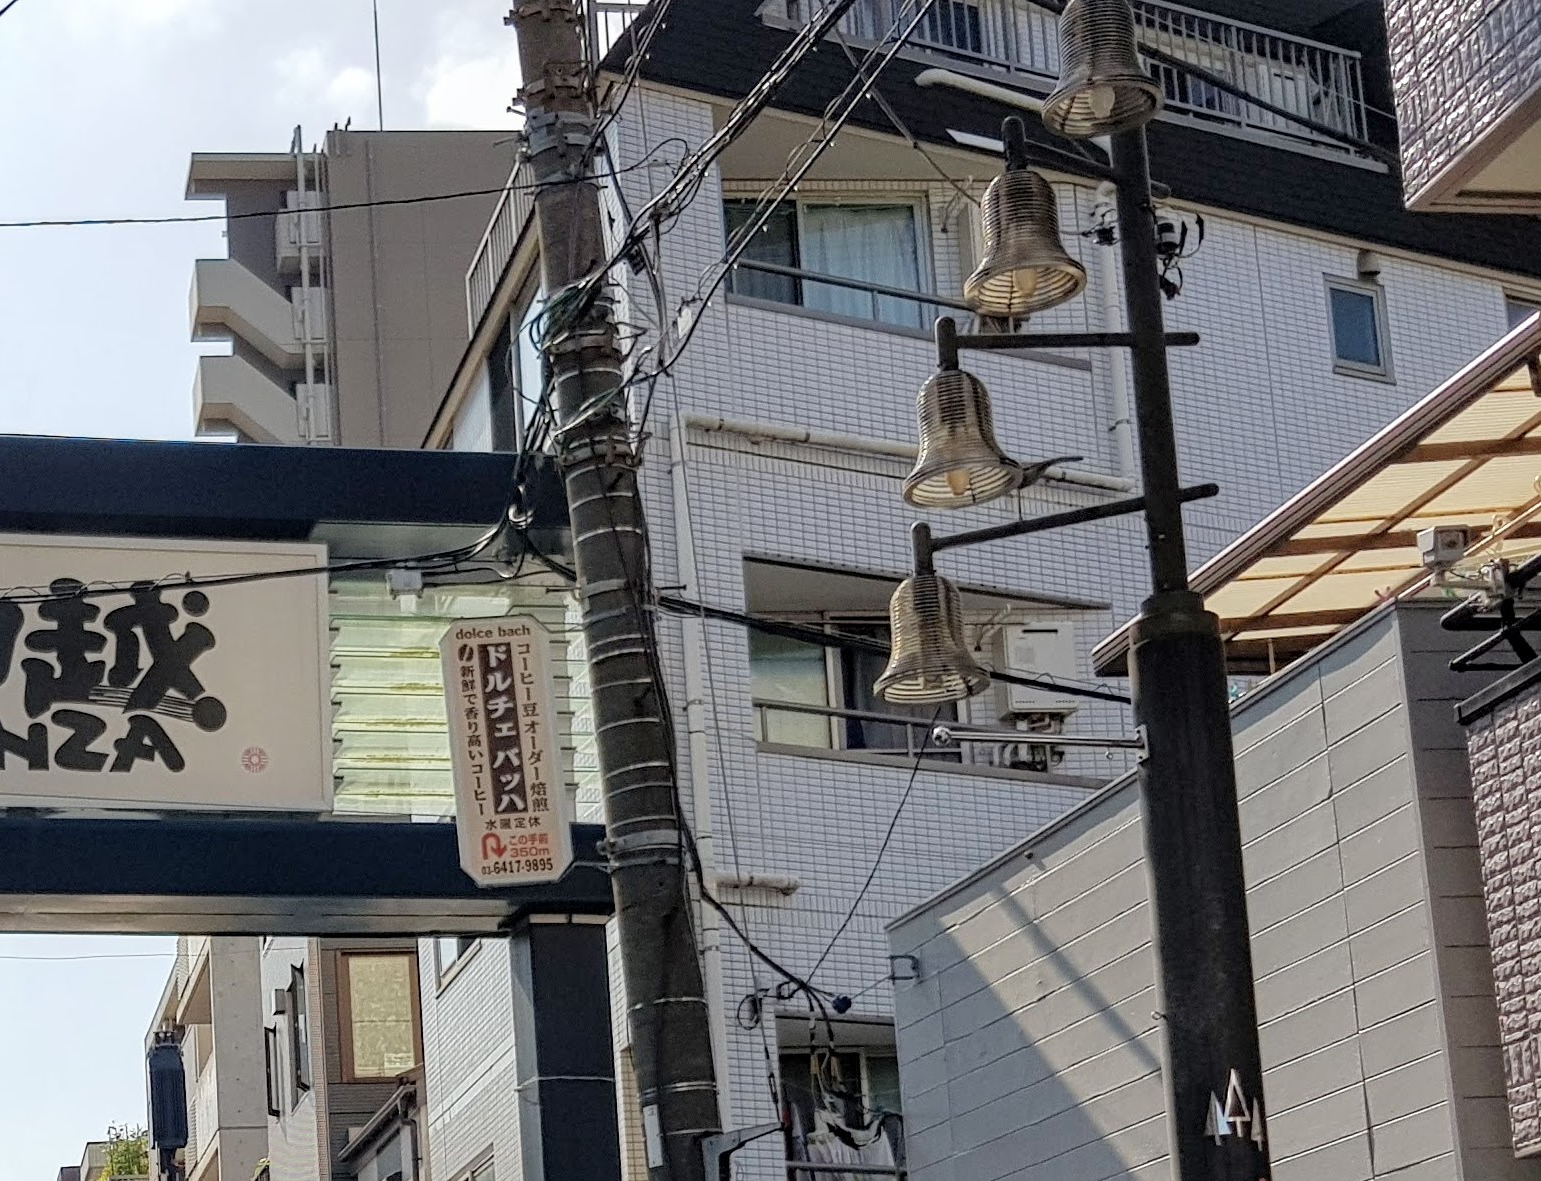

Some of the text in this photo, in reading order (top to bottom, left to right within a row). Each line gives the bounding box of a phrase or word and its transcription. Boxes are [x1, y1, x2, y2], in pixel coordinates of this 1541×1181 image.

[455, 624, 531, 641] dolce bach
[517, 642, 550, 813] コーヒー豆オーダー焙煎
[461, 665, 487, 816] 新鮮で香り高いコーヒー
[484, 816, 542, 831] 水曜定休
[509, 833, 550, 847] この手前
[509, 846, 551, 859] 350m
[481, 858, 554, 876] 03-6417-9895
